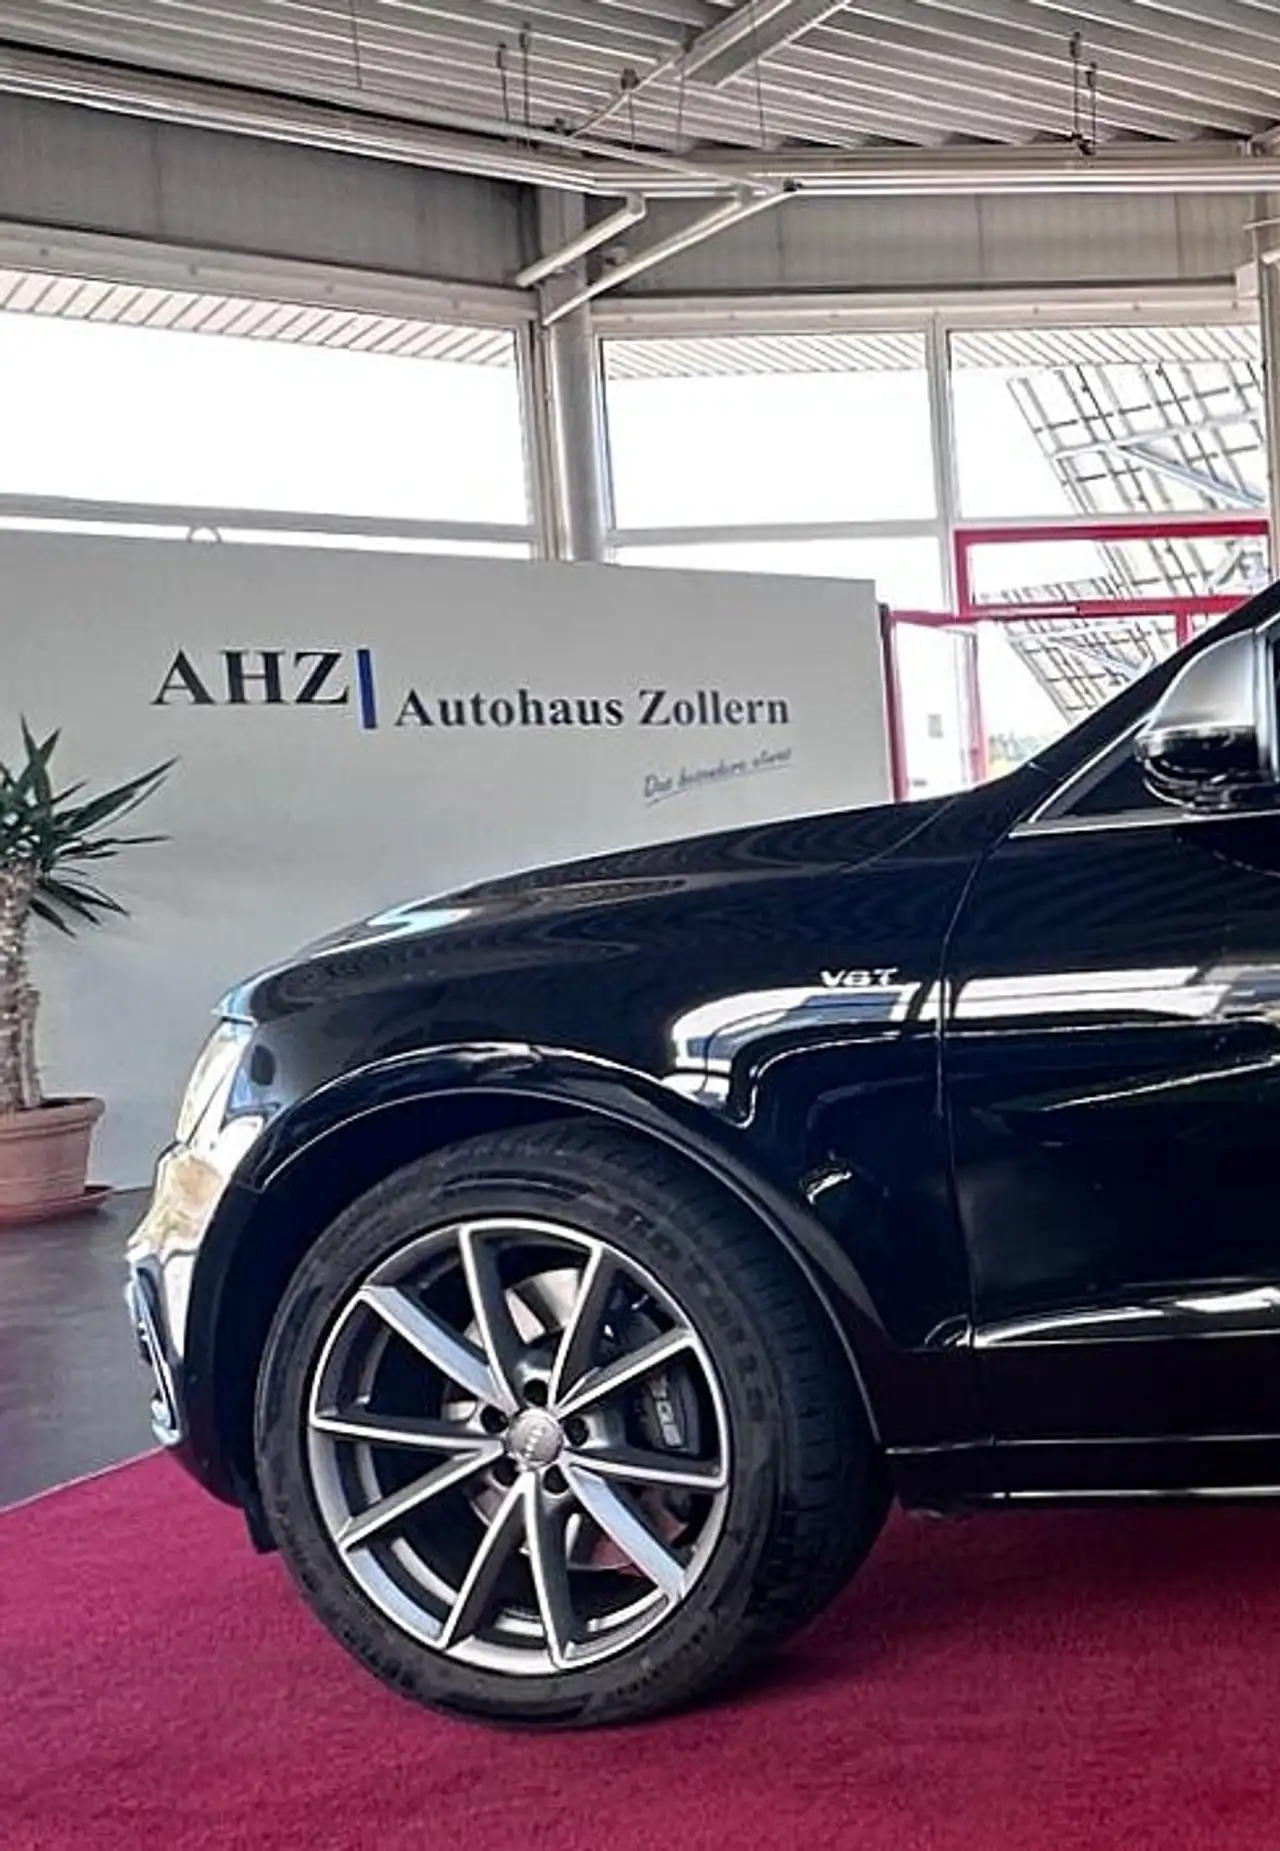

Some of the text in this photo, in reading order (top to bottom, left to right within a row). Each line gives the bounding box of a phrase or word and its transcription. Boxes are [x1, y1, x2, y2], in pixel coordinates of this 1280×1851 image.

[150, 649, 350, 705] AHZ
[394, 688, 790, 726] Autohaus Zollern
